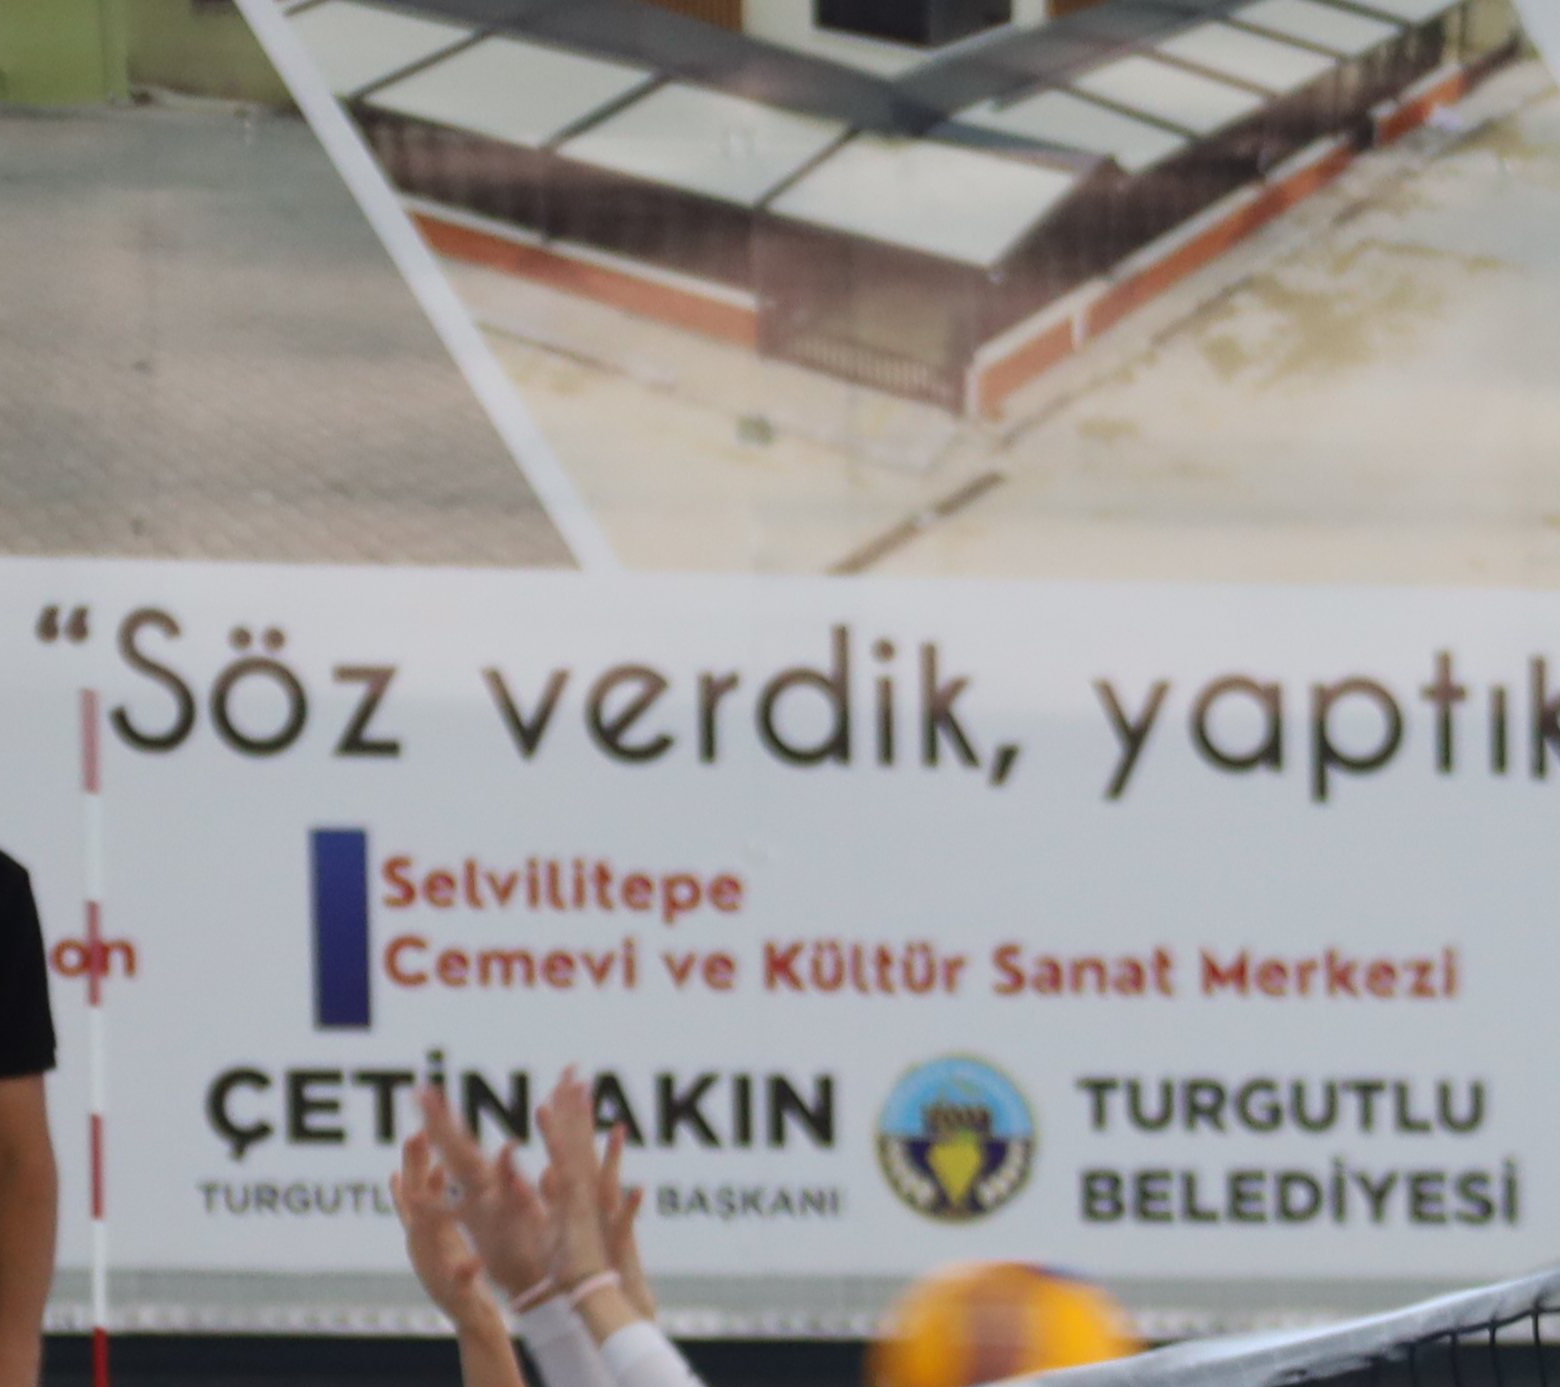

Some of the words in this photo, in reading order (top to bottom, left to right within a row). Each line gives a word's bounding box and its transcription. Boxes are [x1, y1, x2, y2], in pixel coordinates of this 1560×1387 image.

[482, 623, 1023, 788] verdik,
[380, 855, 743, 922] Selvilitepe
[382, 932, 638, 990] Cemevi
[663, 950, 737, 992] ve
[763, 937, 965, 994] Kültür
[992, 943, 1174, 996] Sanat
[1200, 946, 1459, 999] Merkezi
[592, 1071, 836, 1147] AKIN
[1078, 1076, 1486, 1135] TURGUTLU
[198, 1180, 396, 1216] TURGUTL
[1080, 1158, 1519, 1226] BELEDİYESİ
